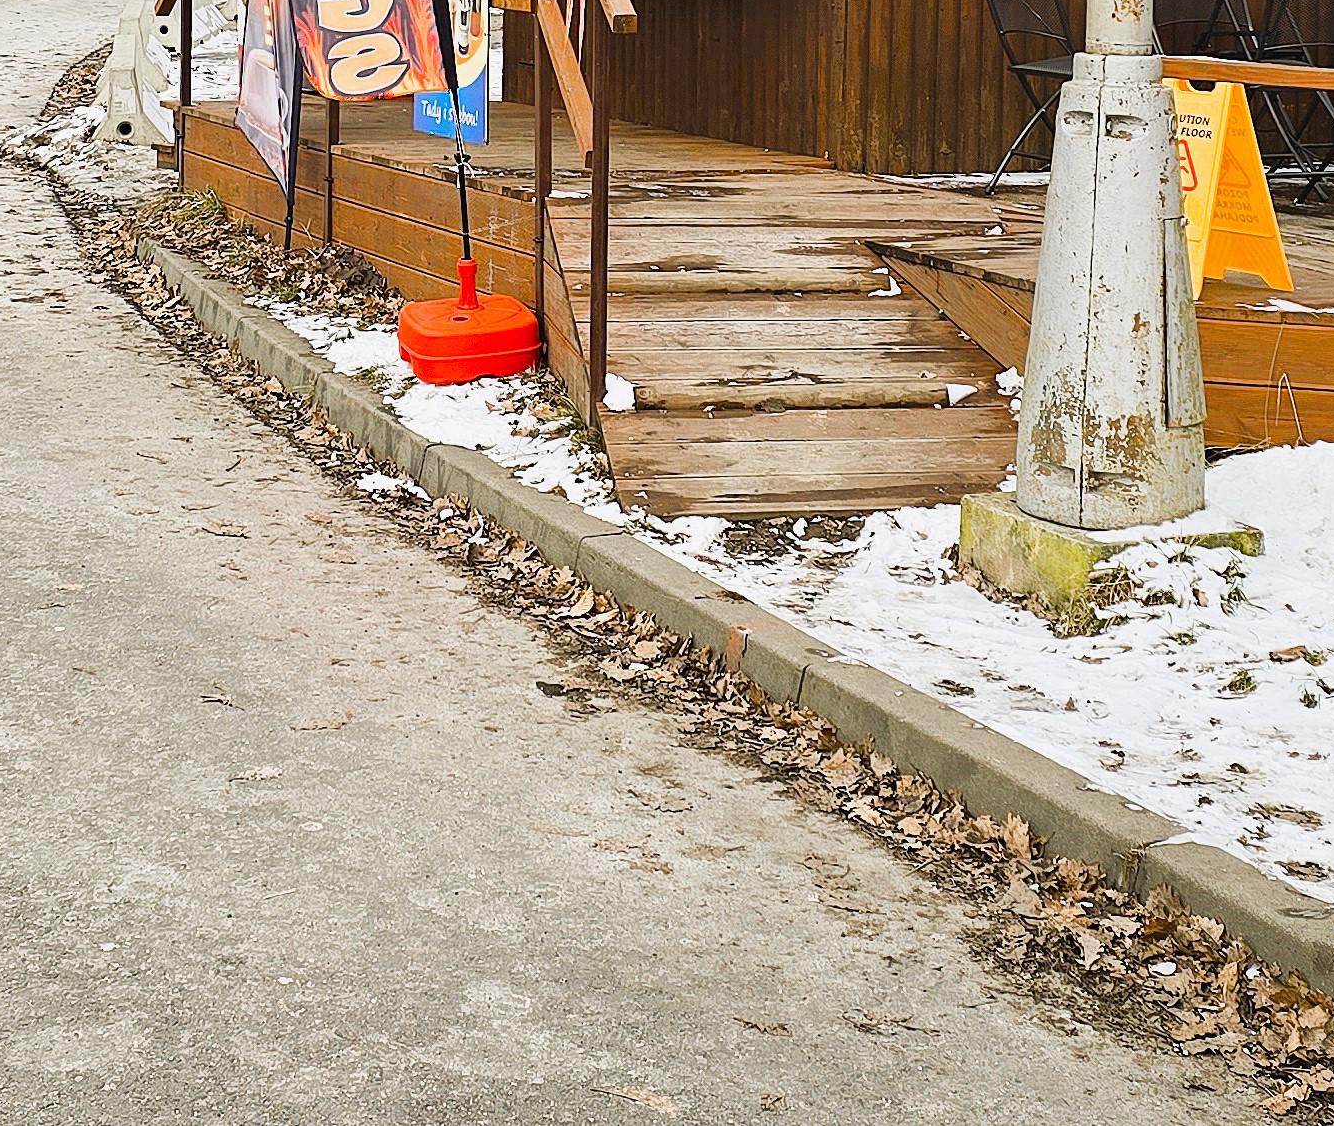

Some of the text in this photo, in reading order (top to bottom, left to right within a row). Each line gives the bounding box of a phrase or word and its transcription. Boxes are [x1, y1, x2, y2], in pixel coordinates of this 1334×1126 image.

[420, 99, 442, 124] Tady
[1179, 114, 1211, 126] UTION
[1181, 127, 1213, 140] FLOOR
